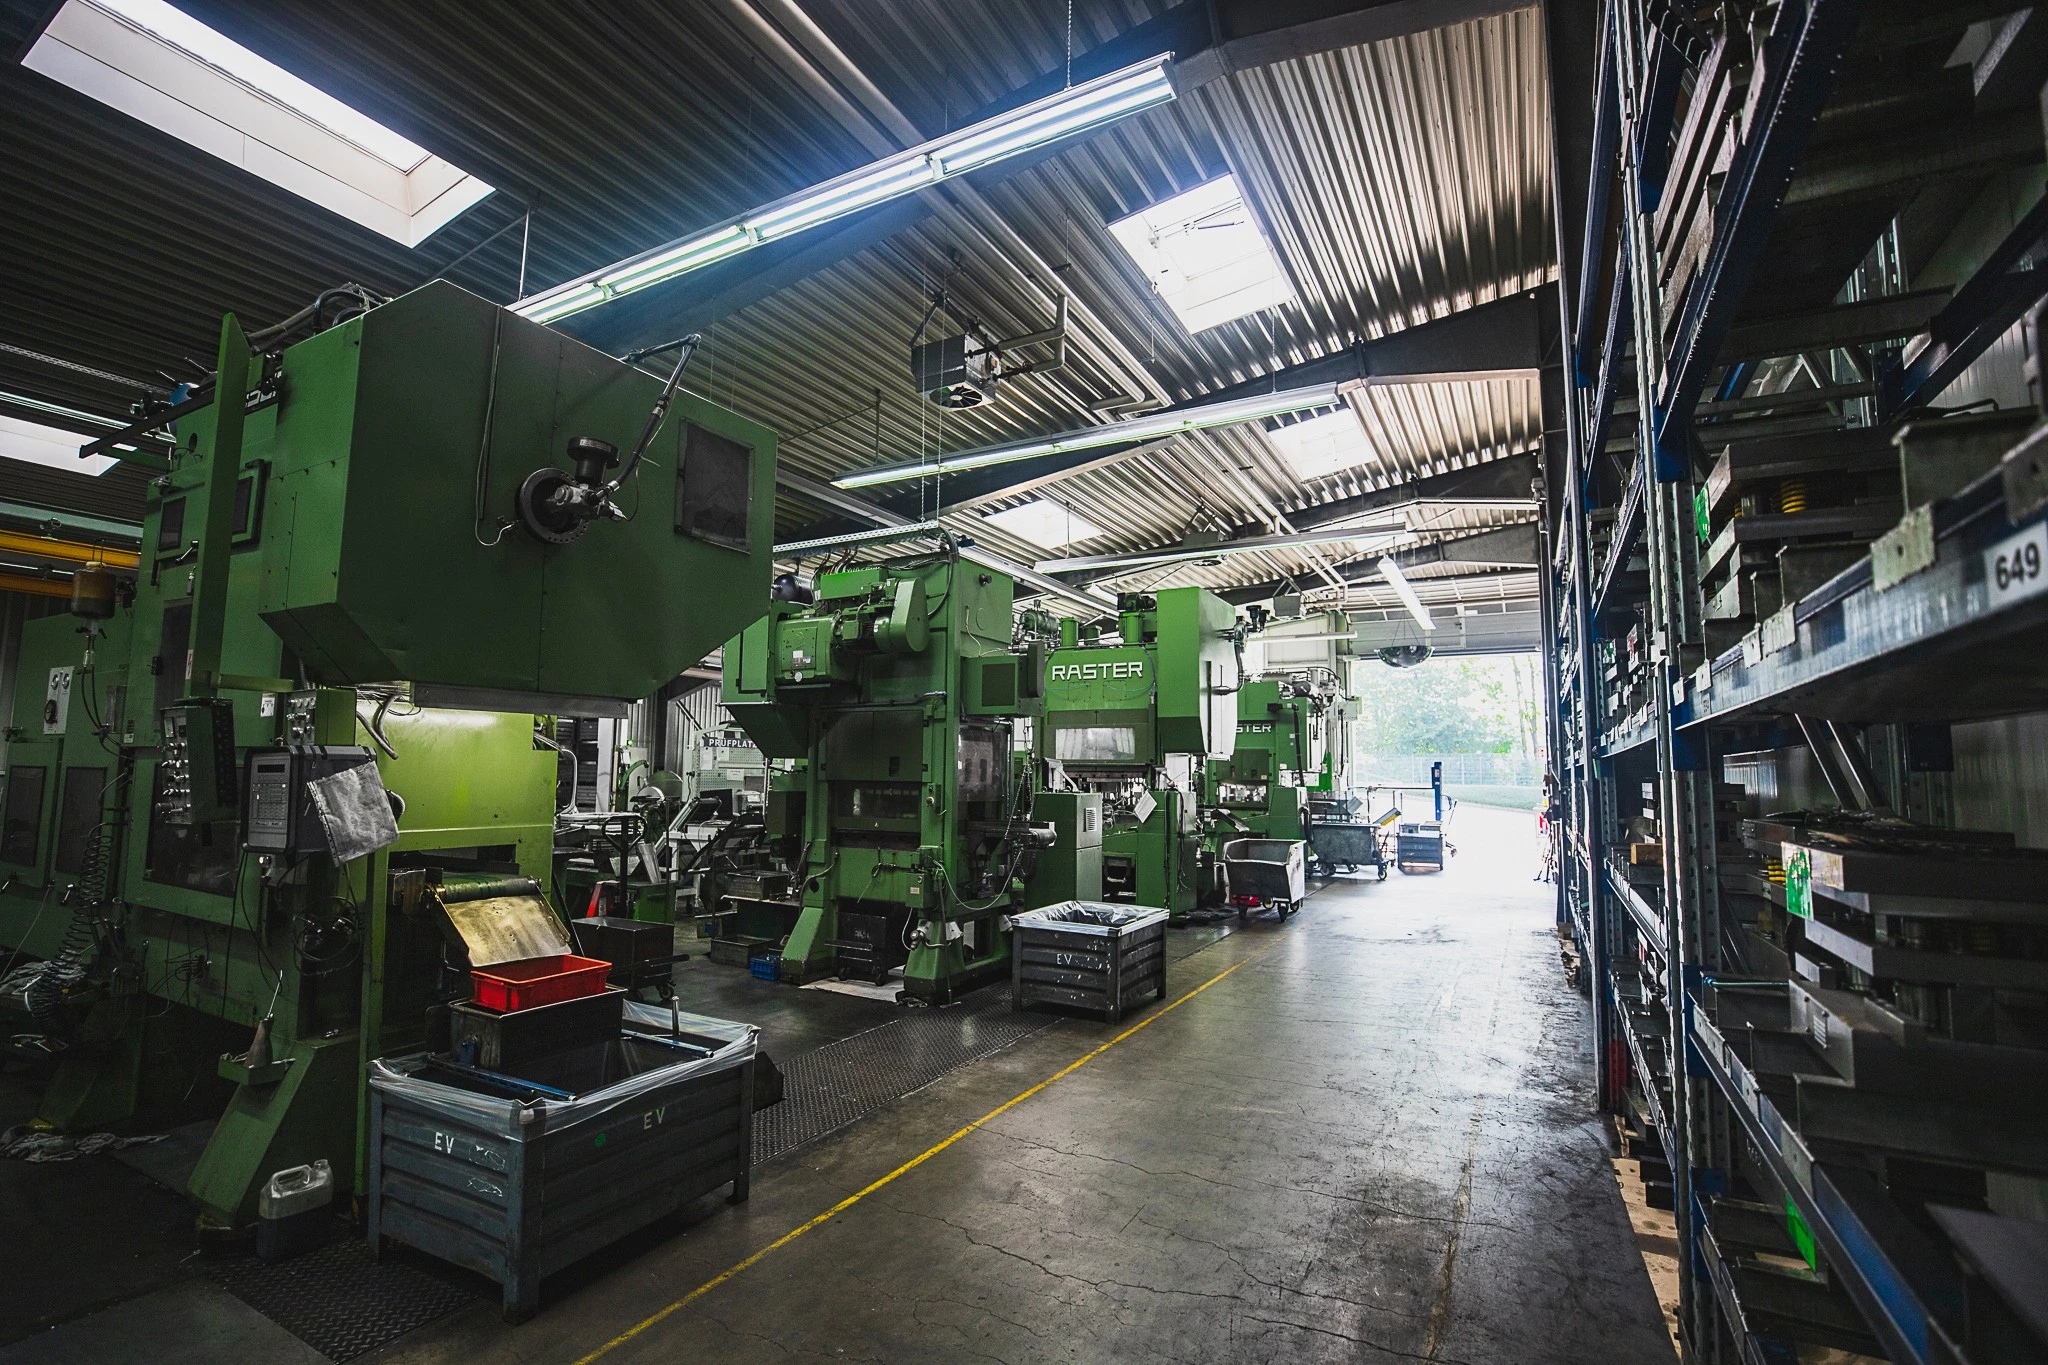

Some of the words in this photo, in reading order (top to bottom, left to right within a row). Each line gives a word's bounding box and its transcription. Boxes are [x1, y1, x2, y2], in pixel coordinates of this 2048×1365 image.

[1995, 542, 2040, 591] 649
[1052, 661, 1143, 681] RASTER
[1236, 723, 1272, 733] STER
[1056, 953, 1073, 965] EV
[643, 1106, 666, 1130] EV
[434, 1131, 455, 1154] EV
